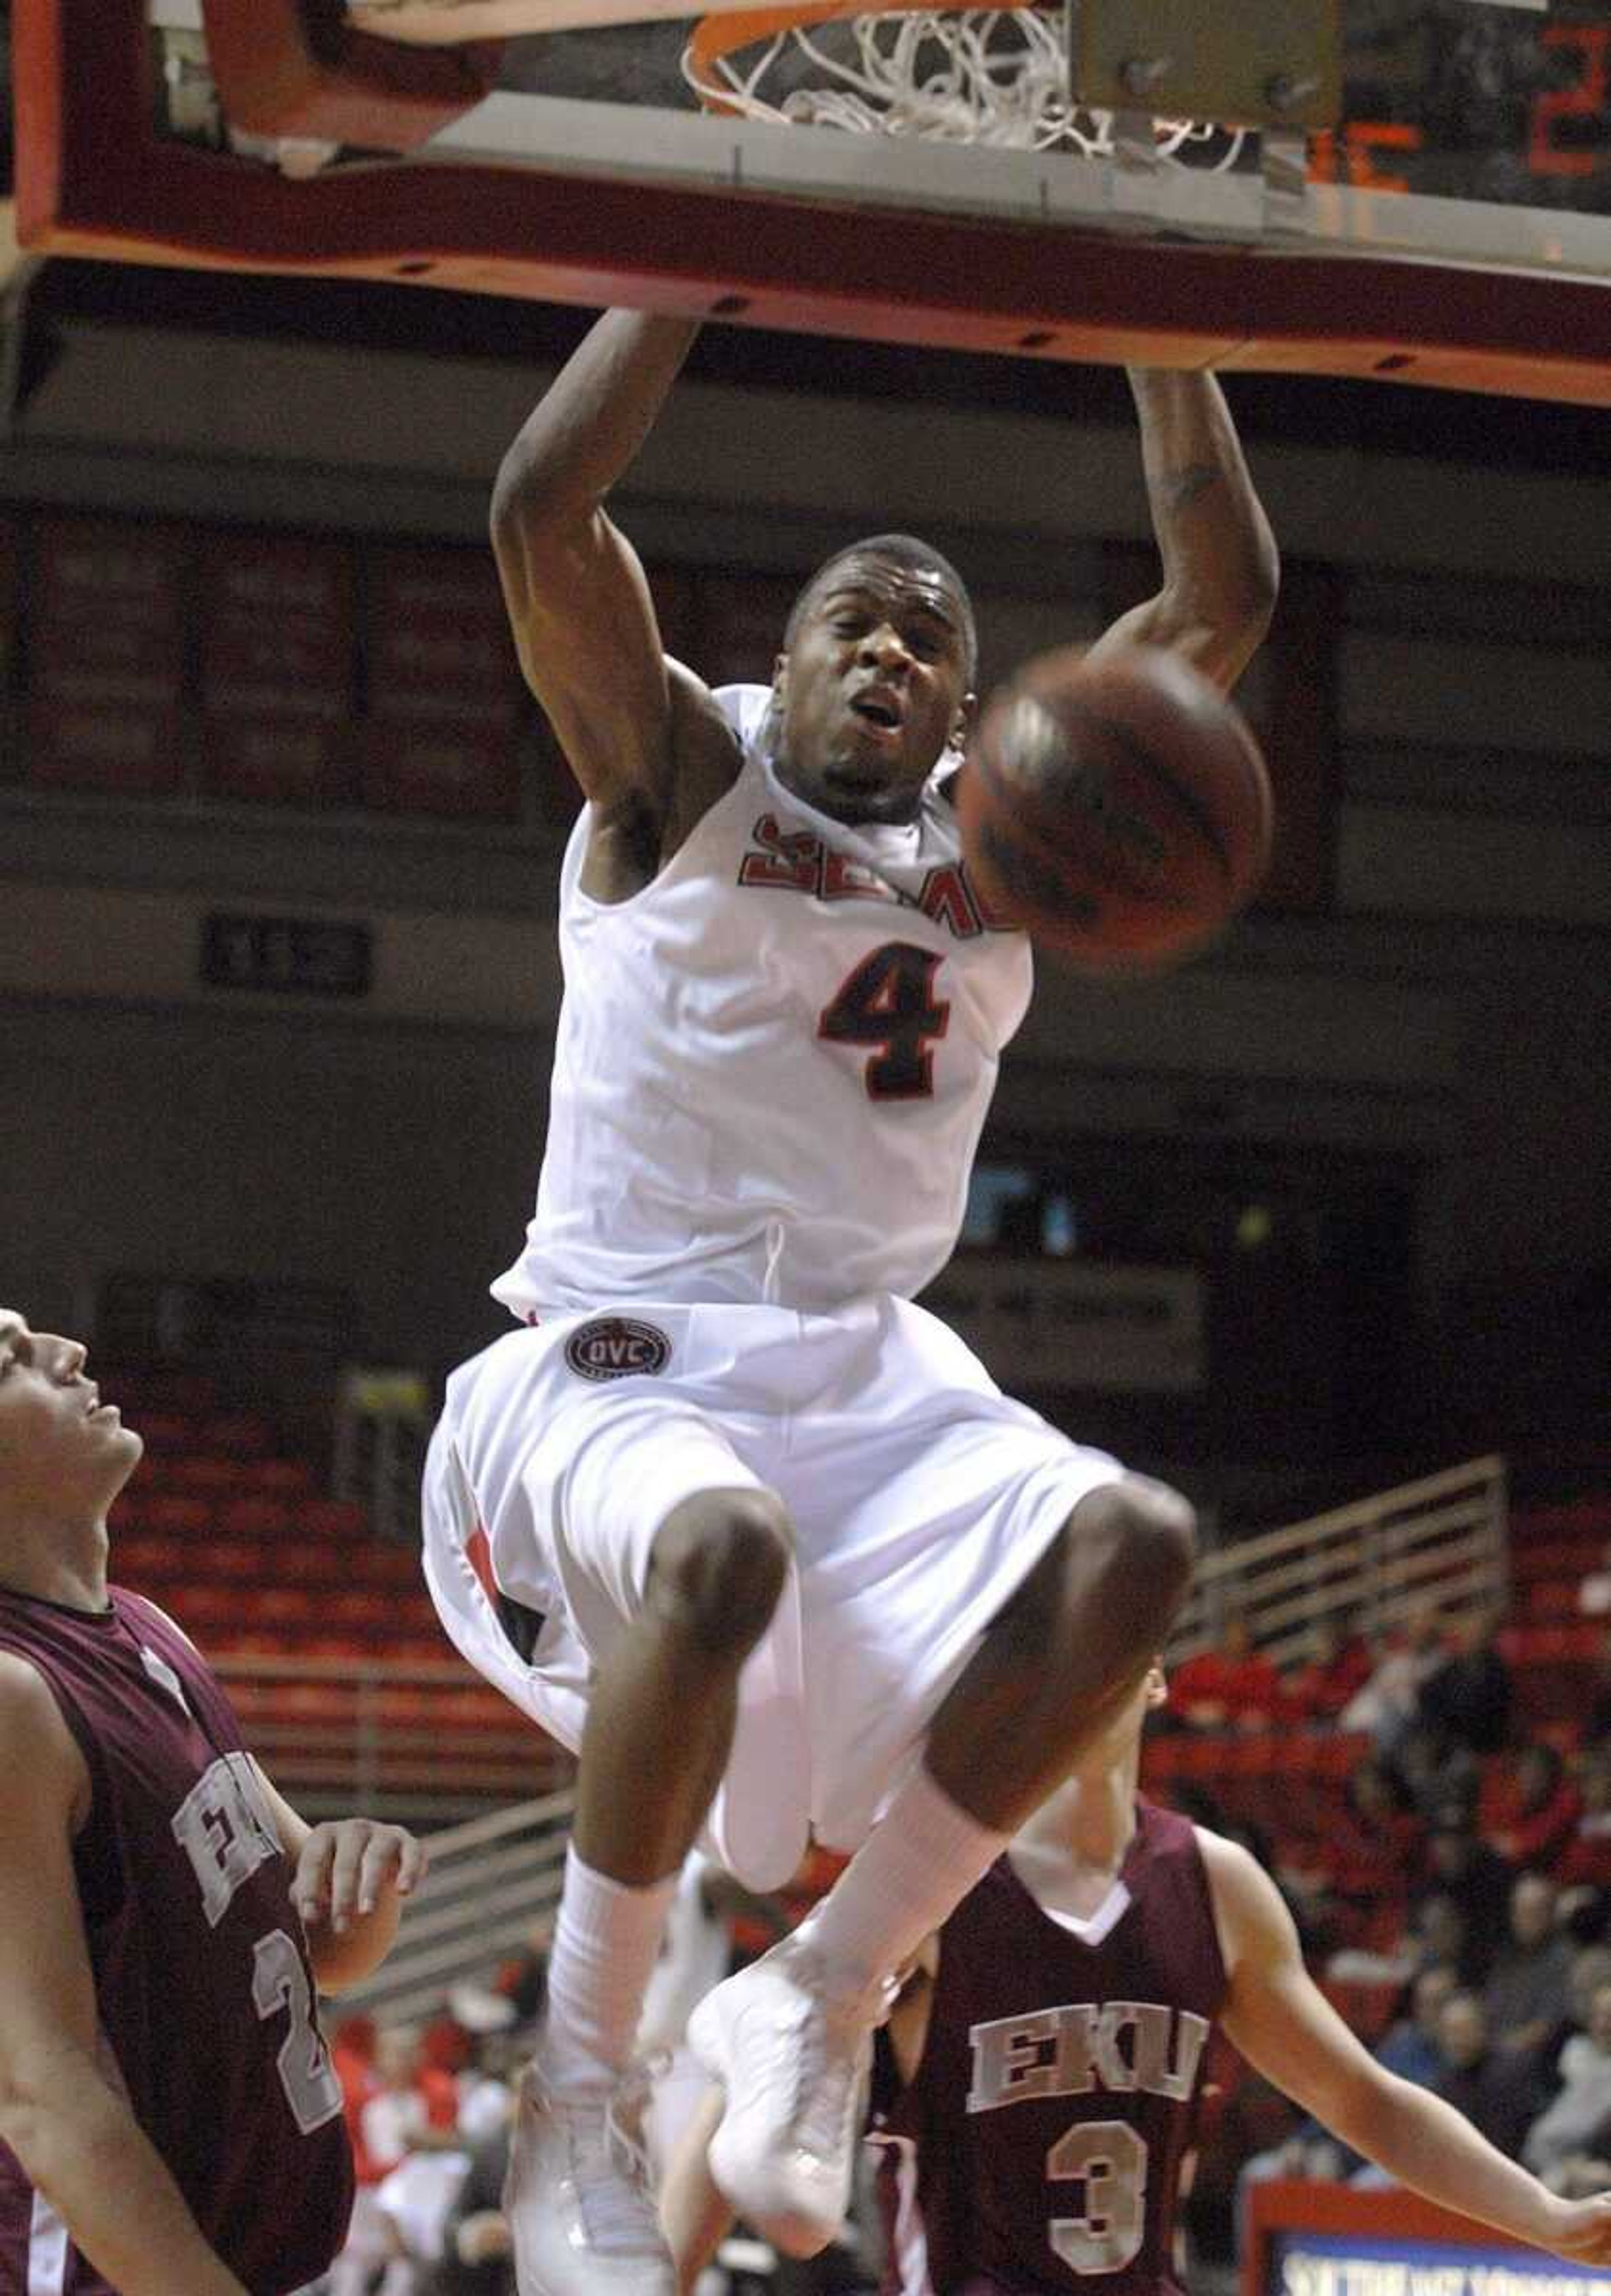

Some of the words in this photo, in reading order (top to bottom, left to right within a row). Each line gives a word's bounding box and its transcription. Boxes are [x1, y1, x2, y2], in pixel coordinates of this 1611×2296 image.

[817, 941, 951, 1102] 4
[588, 1339, 646, 1365] OVC
[252, 1929, 345, 2136] 2
[965, 2001, 1210, 2114] EKU
[1047, 2119, 1149, 2275] 3
